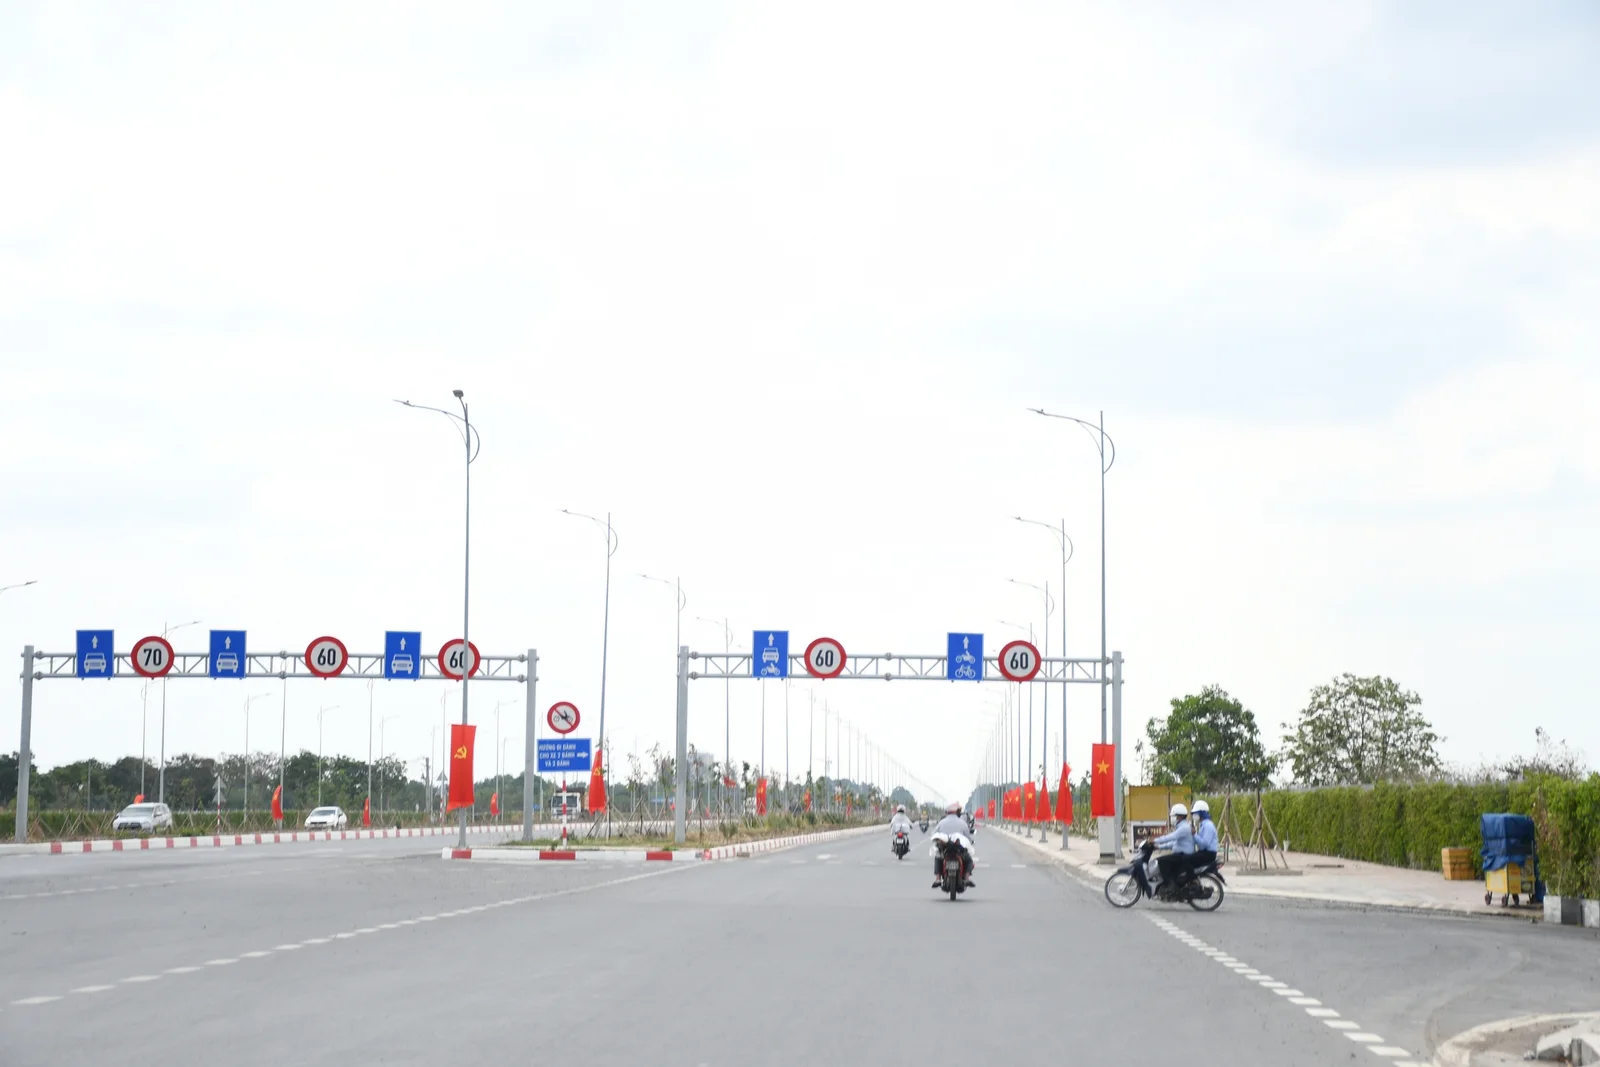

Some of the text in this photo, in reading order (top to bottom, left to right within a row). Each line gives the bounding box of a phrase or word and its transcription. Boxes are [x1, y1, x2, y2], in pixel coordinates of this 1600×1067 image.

[144, 648, 162, 666] 70
[318, 648, 336, 666] 60
[816, 649, 834, 667] 60
[1010, 652, 1028, 669] 60
